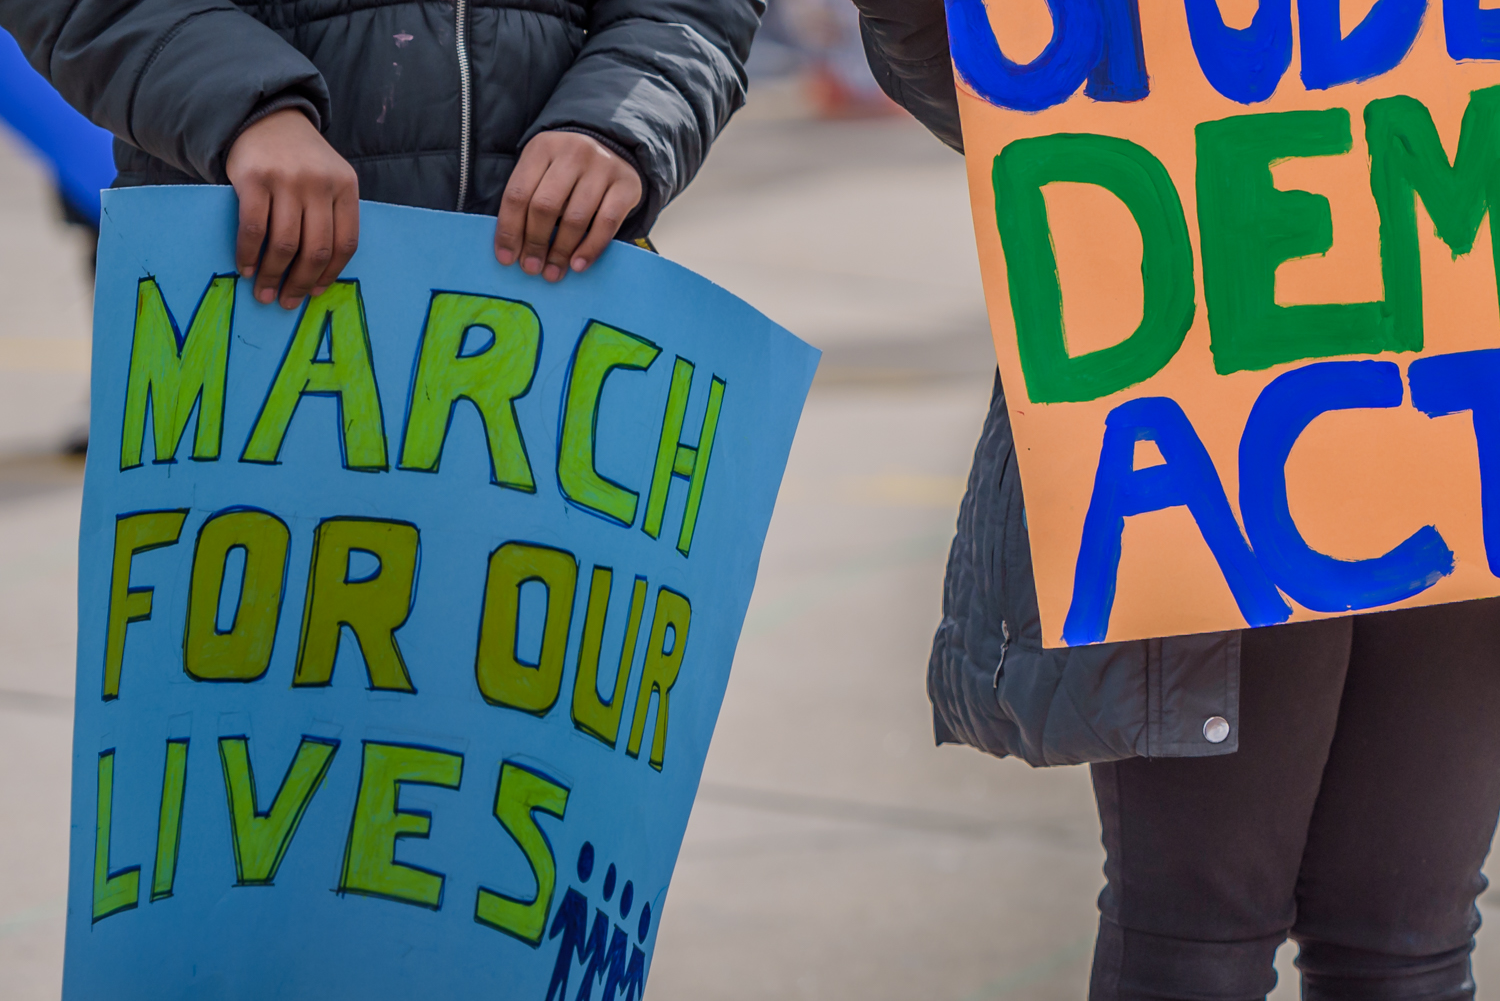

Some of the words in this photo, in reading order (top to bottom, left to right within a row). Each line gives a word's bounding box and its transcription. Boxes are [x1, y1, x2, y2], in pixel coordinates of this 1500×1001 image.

[120, 272, 727, 557] MARCH
[101, 505, 422, 702] FOR
[474, 540, 693, 772] OUR
[91, 734, 571, 949] LIVES
